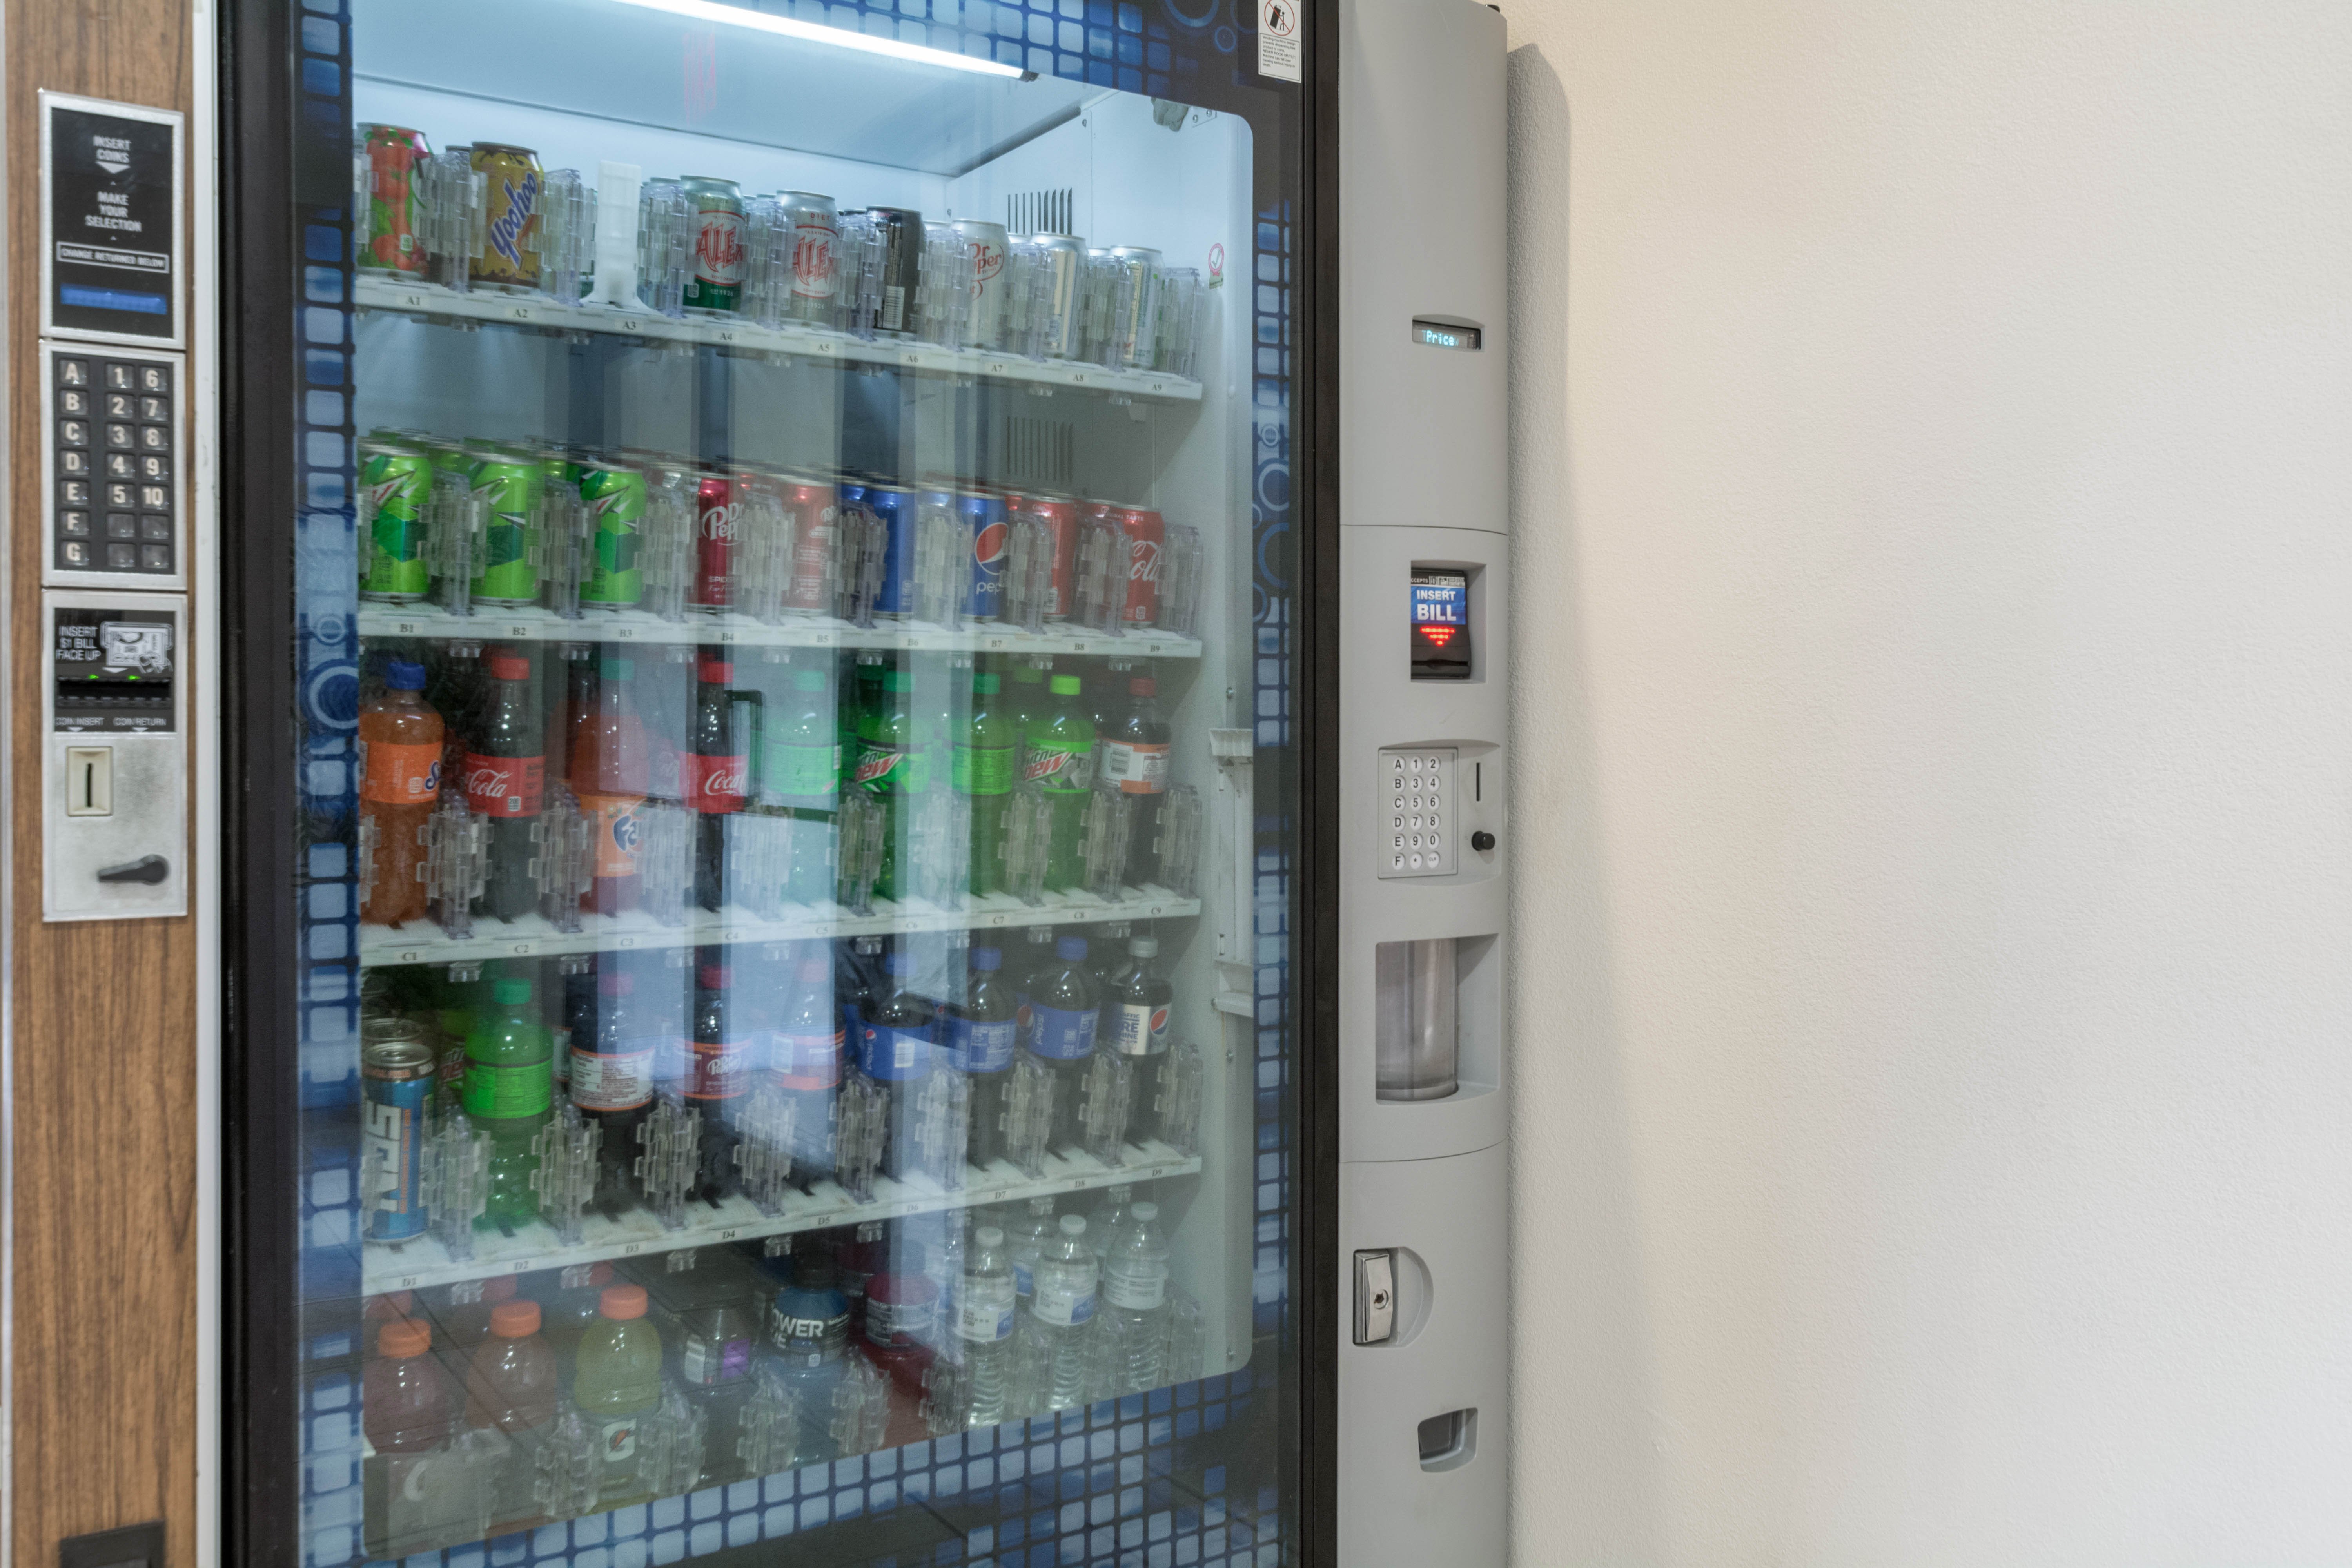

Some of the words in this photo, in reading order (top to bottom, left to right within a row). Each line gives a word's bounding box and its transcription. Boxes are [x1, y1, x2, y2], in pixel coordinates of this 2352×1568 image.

[93, 135, 131, 151] INSERT
[96, 149, 130, 163] COINS
[98, 191, 129, 206] MAKE
[100, 205, 128, 218] YOUR
[810, 213, 830, 221] DIET
[85, 215, 142, 232] SELECTION
[61, 247, 94, 261] CHANGE
[95, 250, 136, 265] RETURNED
[137, 256, 165, 268] BELOW
[406, 296, 421, 305] A1
[514, 309, 528, 318] A2
[623, 321, 636, 330] A3
[720, 332, 733, 341] A4
[1426, 329, 1454, 346] Price
[818, 344, 830, 352] A5
[907, 355, 919, 363] A6
[65, 363, 78, 381] A
[114, 367, 123, 384] 1
[146, 370, 158, 388] 6
[66, 392, 79, 411] B
[112, 397, 124, 415] 2
[147, 399, 158, 417] 7
[65, 422, 79, 441] C
[113, 426, 125, 444] 3
[147, 429, 159, 446] 8
[66, 453, 79, 470] D
[112, 455, 125, 474] 4
[147, 458, 159, 476] 9
[67, 483, 80, 501] E
[113, 485, 125, 503] 5
[144, 488, 163, 505] 10
[67, 513, 80, 531] F
[67, 543, 81, 561] G
[976, 582, 1000, 595] pep
[1417, 590, 1455, 601] INSERT
[1417, 604, 1456, 621] BILL
[59, 626, 98, 637] INSERT
[401, 624, 414, 633] B1
[513, 627, 526, 636] B2
[620, 629, 632, 637] B3
[74, 638, 96, 649] BILL
[817, 635, 829, 643] B5
[56, 649, 84, 661] FACE
[85, 650, 101, 661] UP
[56, 717, 75, 725] COIN
[76, 717, 105, 726] INSERT
[113, 717, 135, 726] COIN
[136, 717, 167, 726] RETURN
[1395, 759, 1401, 769] A
[1414, 759, 1417, 768] 1
[1430, 759, 1436, 768] 2
[1395, 779, 1401, 788] B
[1413, 779, 1418, 788] 3
[1430, 778, 1436, 787] 4
[1394, 798, 1401, 808] C
[1413, 798, 1418, 807] 5
[1430, 797, 1436, 807] 6
[1395, 817, 1401, 827] D
[1413, 817, 1418, 826] 7
[1430, 817, 1435, 826] 8
[1395, 837, 1401, 846] E
[1413, 836, 1418, 846] 9
[1430, 835, 1435, 845] 0
[1395, 856, 1401, 866] F
[1151, 907, 1161, 915] C9
[906, 921, 918, 929] C6
[993, 916, 1004, 924] C7
[815, 926, 829, 935] C5
[725, 932, 739, 941] C4
[620, 938, 634, 947] C3
[515, 945, 529, 953] C2
[402, 952, 417, 961] C1
[1075, 1180, 1085, 1188] D8
[995, 1191, 1006, 1199] D7
[907, 1203, 919, 1212] D6
[818, 1216, 830, 1225] D5
[722, 1230, 735, 1239] D4
[626, 1244, 639, 1253] D3
[514, 1261, 529, 1270] D2
[403, 1277, 417, 1287] D1
